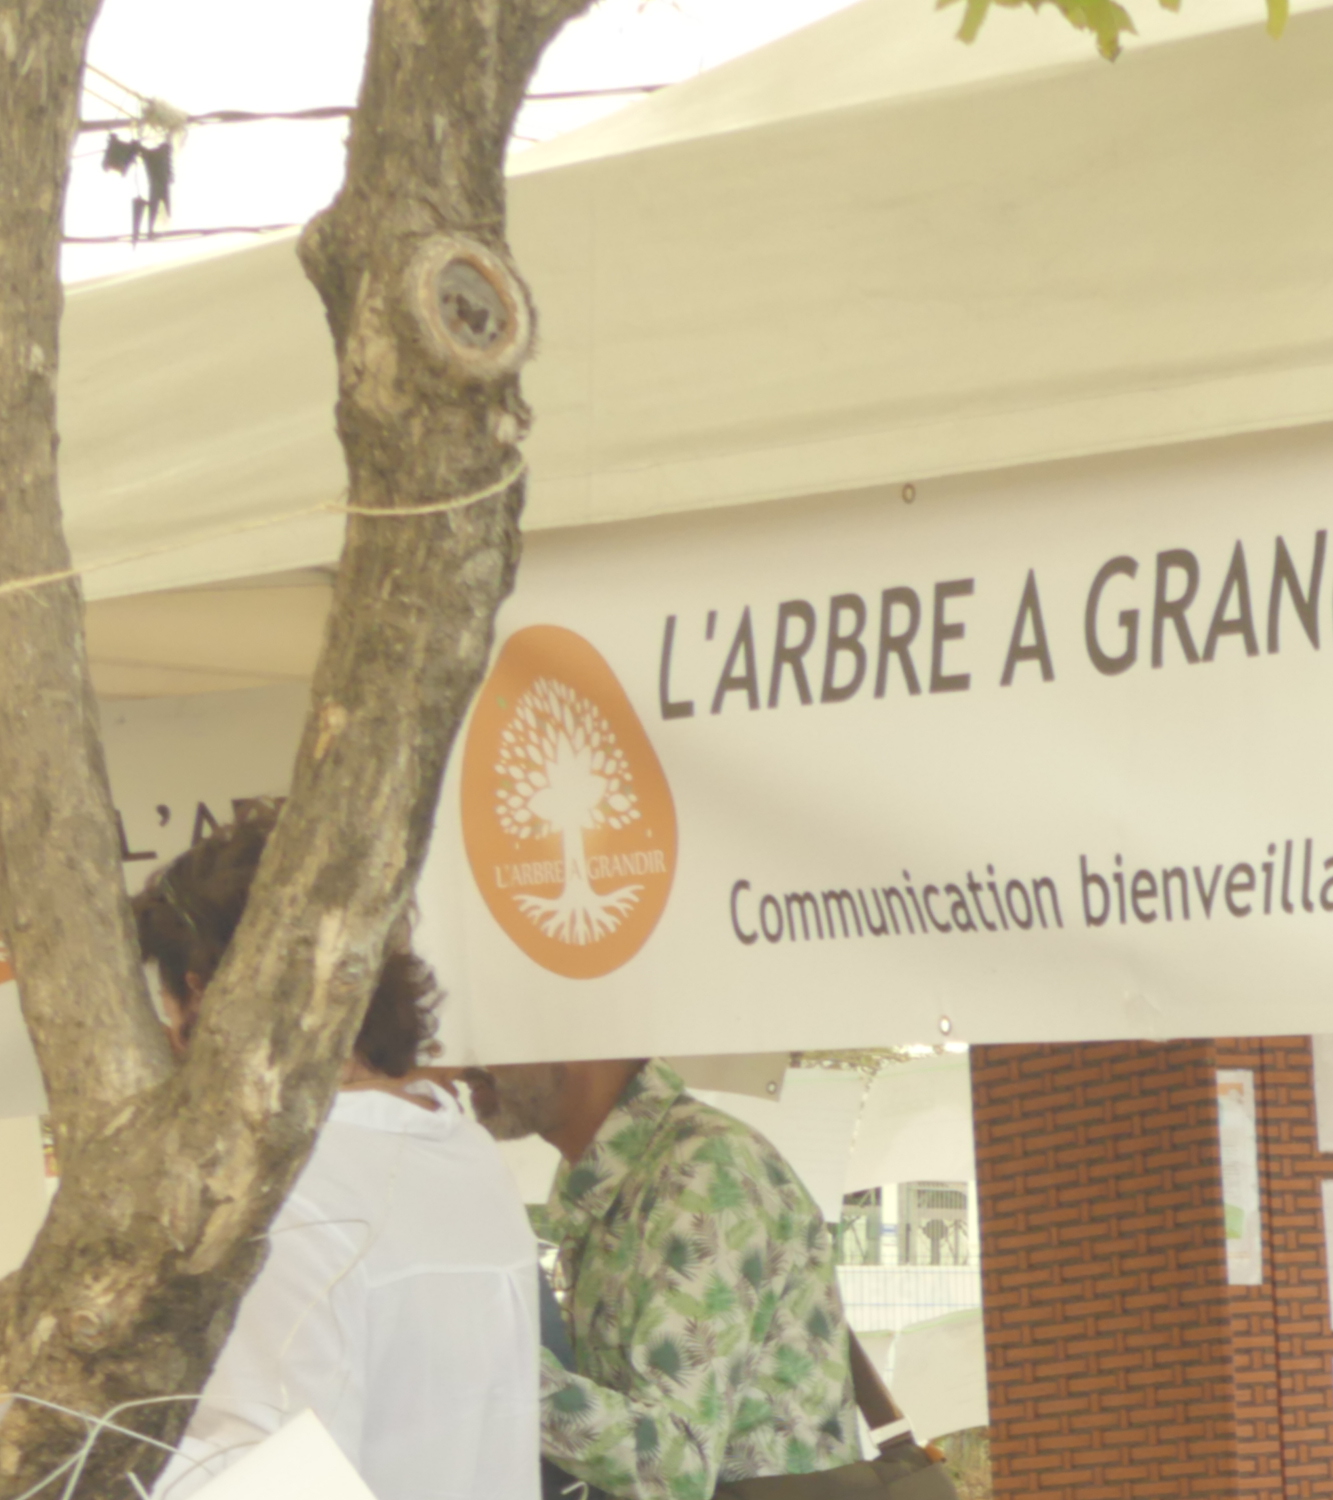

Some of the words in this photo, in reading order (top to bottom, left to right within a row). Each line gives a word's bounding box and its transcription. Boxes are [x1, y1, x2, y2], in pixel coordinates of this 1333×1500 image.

[658, 577, 975, 721] L'ARBRE
[999, 567, 1055, 688] A
[494, 859, 565, 889] L'ARBRE
[587, 849, 667, 881] GRANDIR
[729, 860, 1064, 945] Communication
